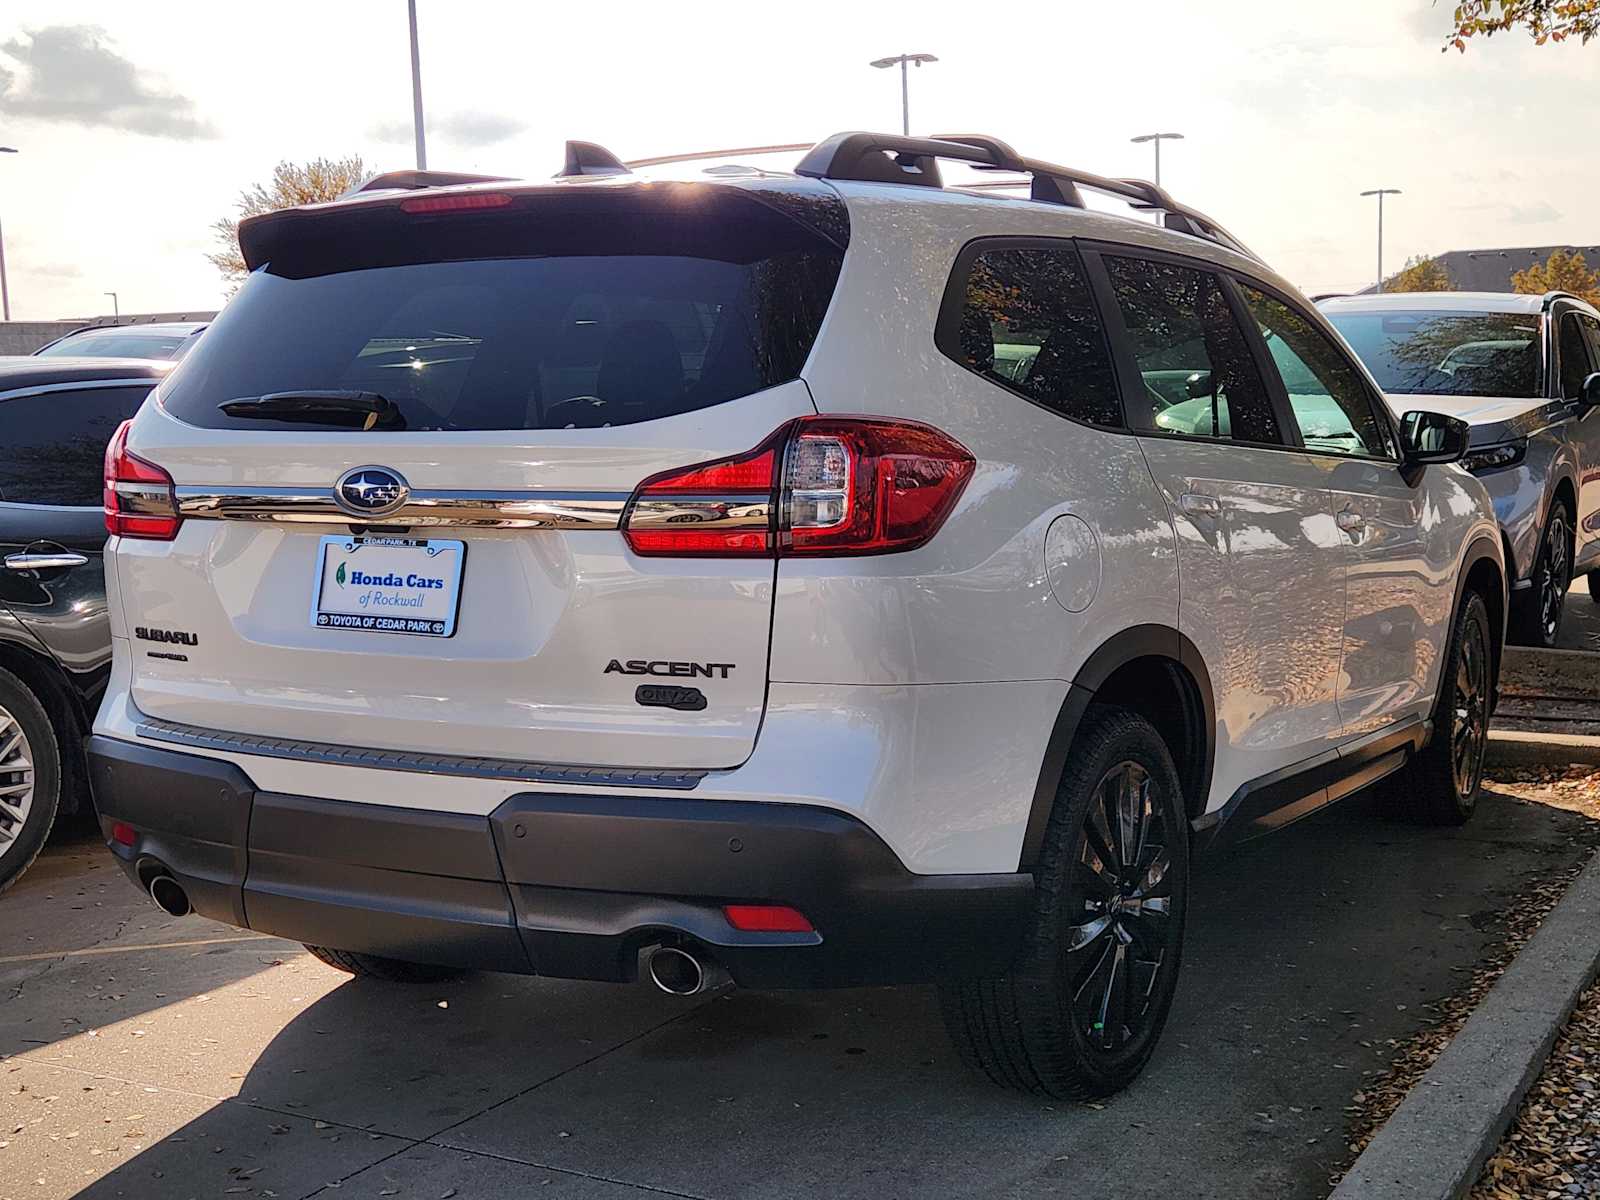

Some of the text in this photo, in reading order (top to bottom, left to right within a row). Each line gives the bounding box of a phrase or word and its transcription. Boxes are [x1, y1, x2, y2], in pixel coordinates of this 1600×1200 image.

[351, 571, 443, 589] Honda Cars
[359, 591, 425, 608] of Rockwall
[329, 615, 431, 632] TOYOTA OF CEDAR PARK
[135, 626, 198, 646] SUBARU
[603, 659, 736, 678] ASCENT
